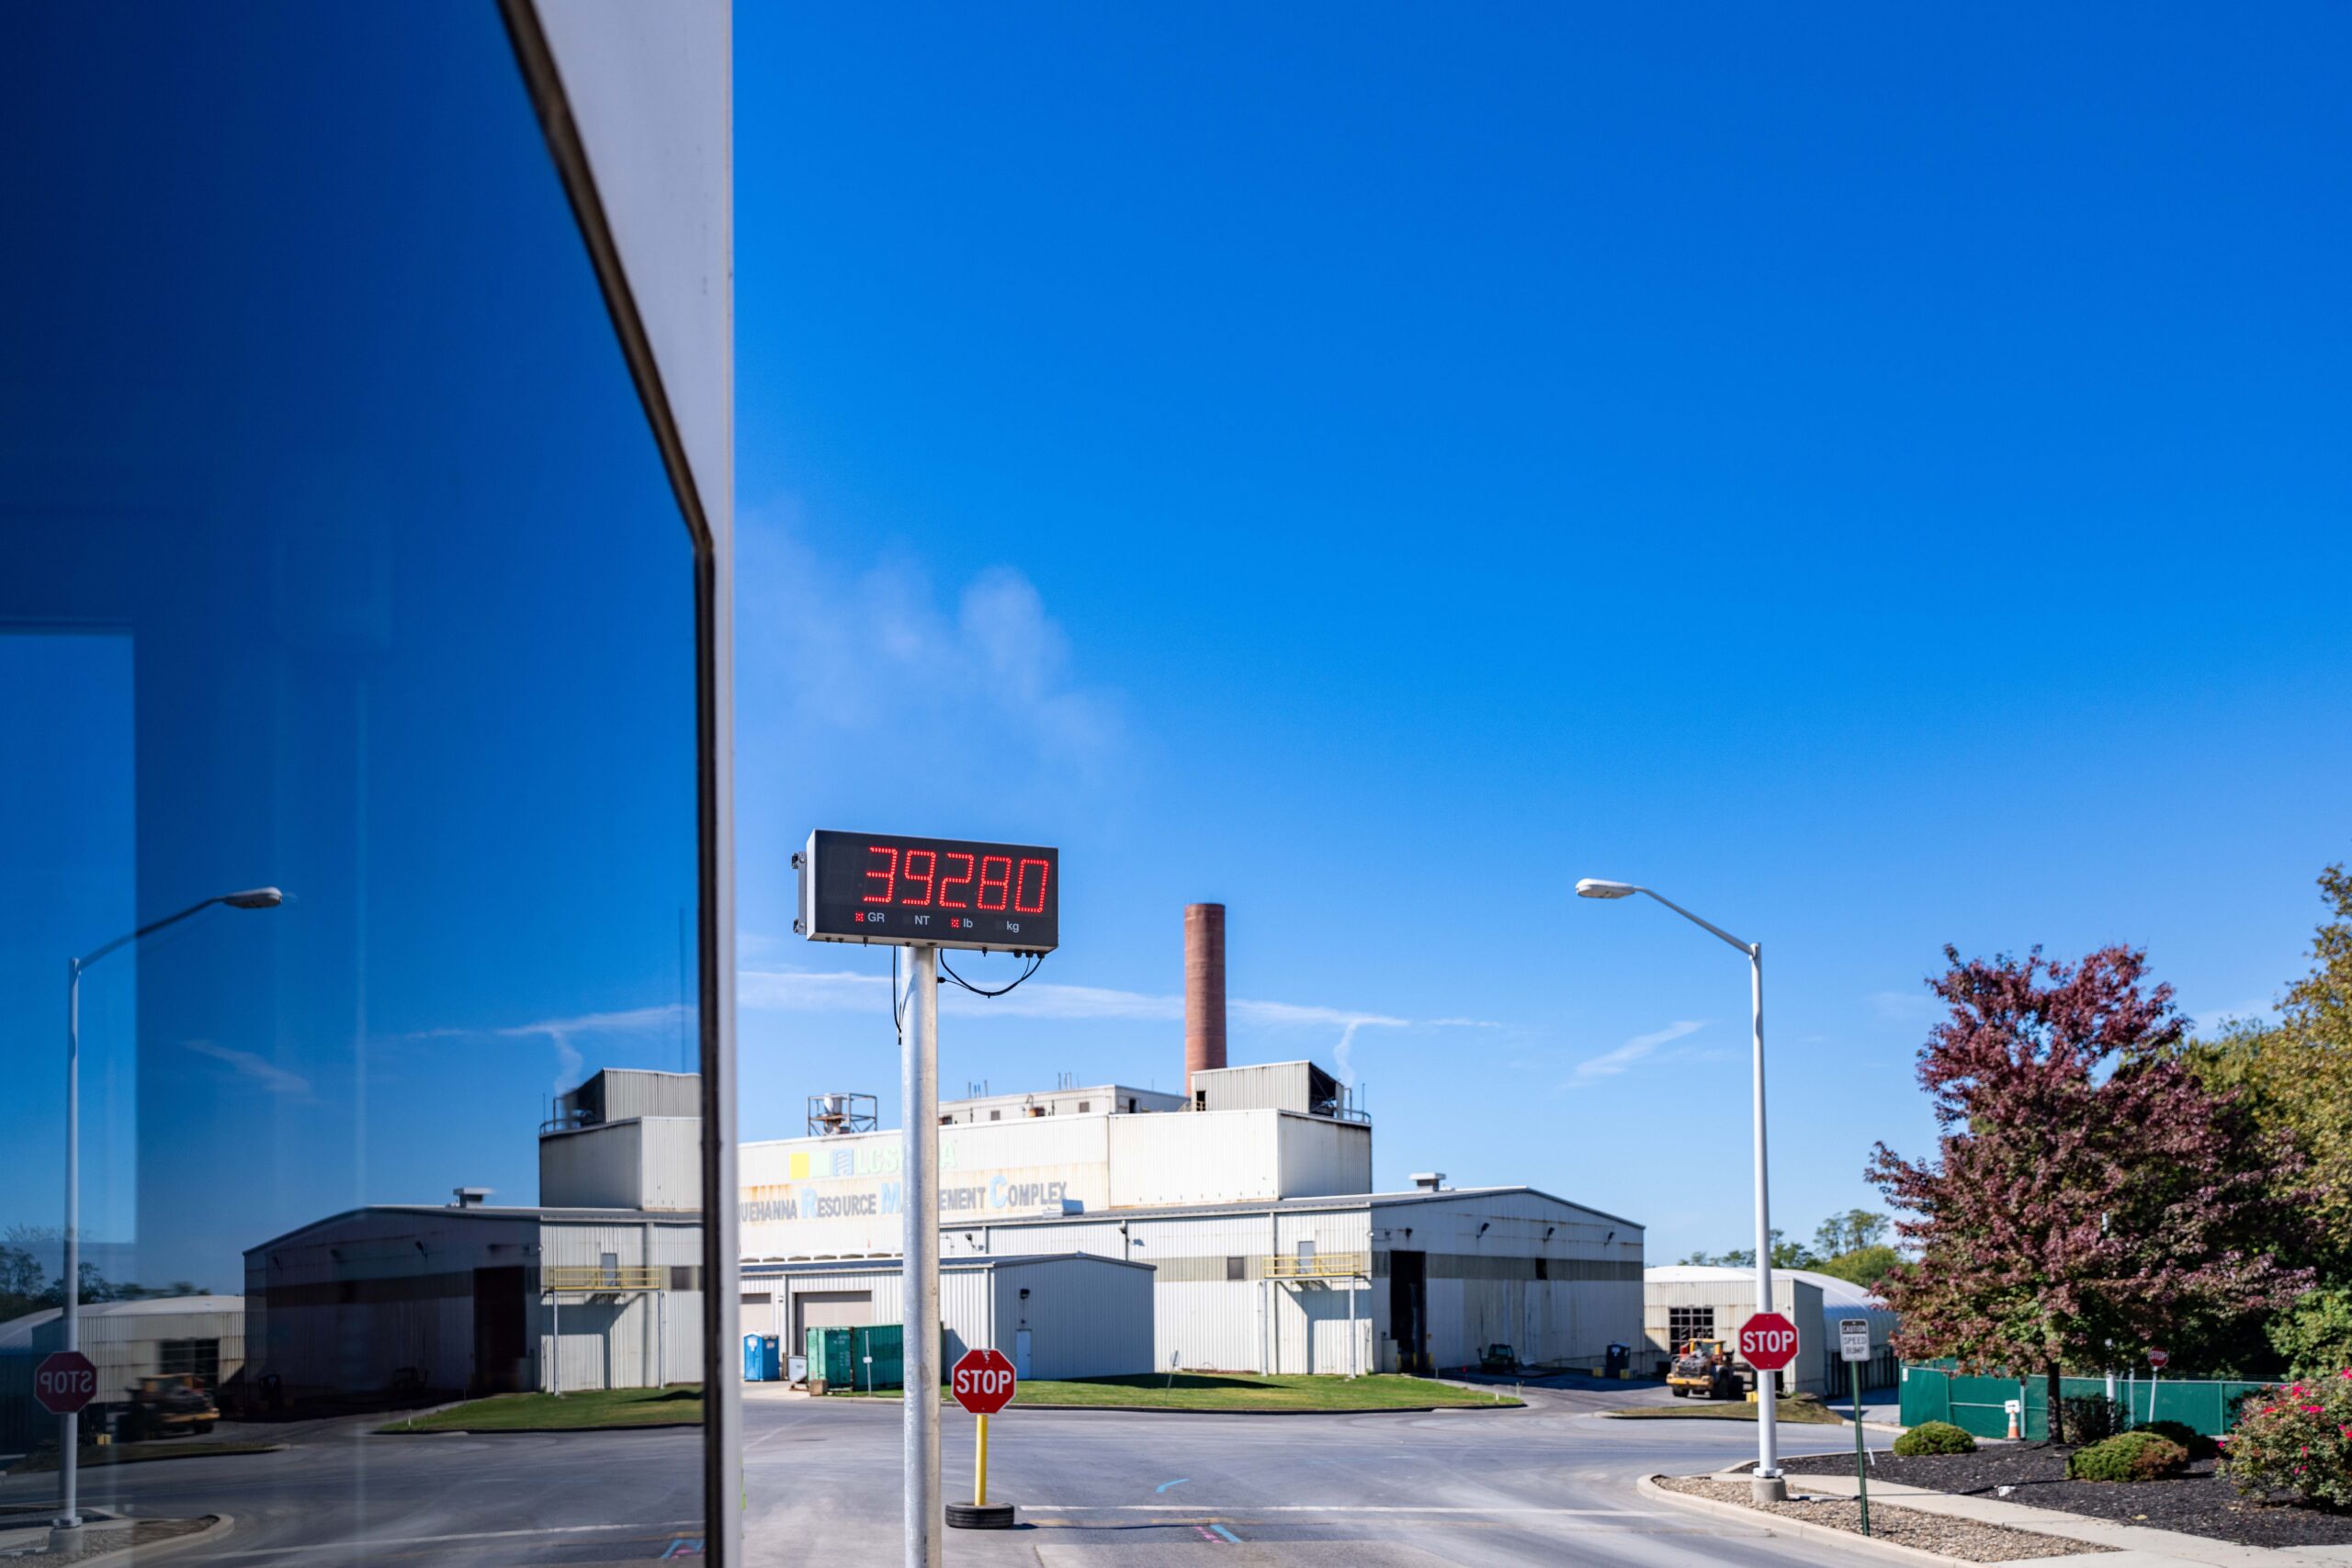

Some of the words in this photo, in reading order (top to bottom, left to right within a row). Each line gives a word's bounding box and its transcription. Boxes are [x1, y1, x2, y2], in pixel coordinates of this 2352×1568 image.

[863, 846, 1049, 914] 39280
[867, 911, 886, 923] GR
[914, 915, 931, 927] NT
[963, 919, 974, 929] lb
[1006, 920, 1020, 932] kg
[738, 1198, 798, 1224] UEHANNA
[800, 1188, 877, 1219] RESOURCE
[881, 1182, 986, 1214] MEMENT
[990, 1175, 1068, 1209] COMPLEX
[1743, 1330, 1795, 1353] STOP
[1843, 1337, 1867, 1346] SPEED
[1845, 1347, 1865, 1355] BUMP
[956, 1369, 1012, 1394] STOP
